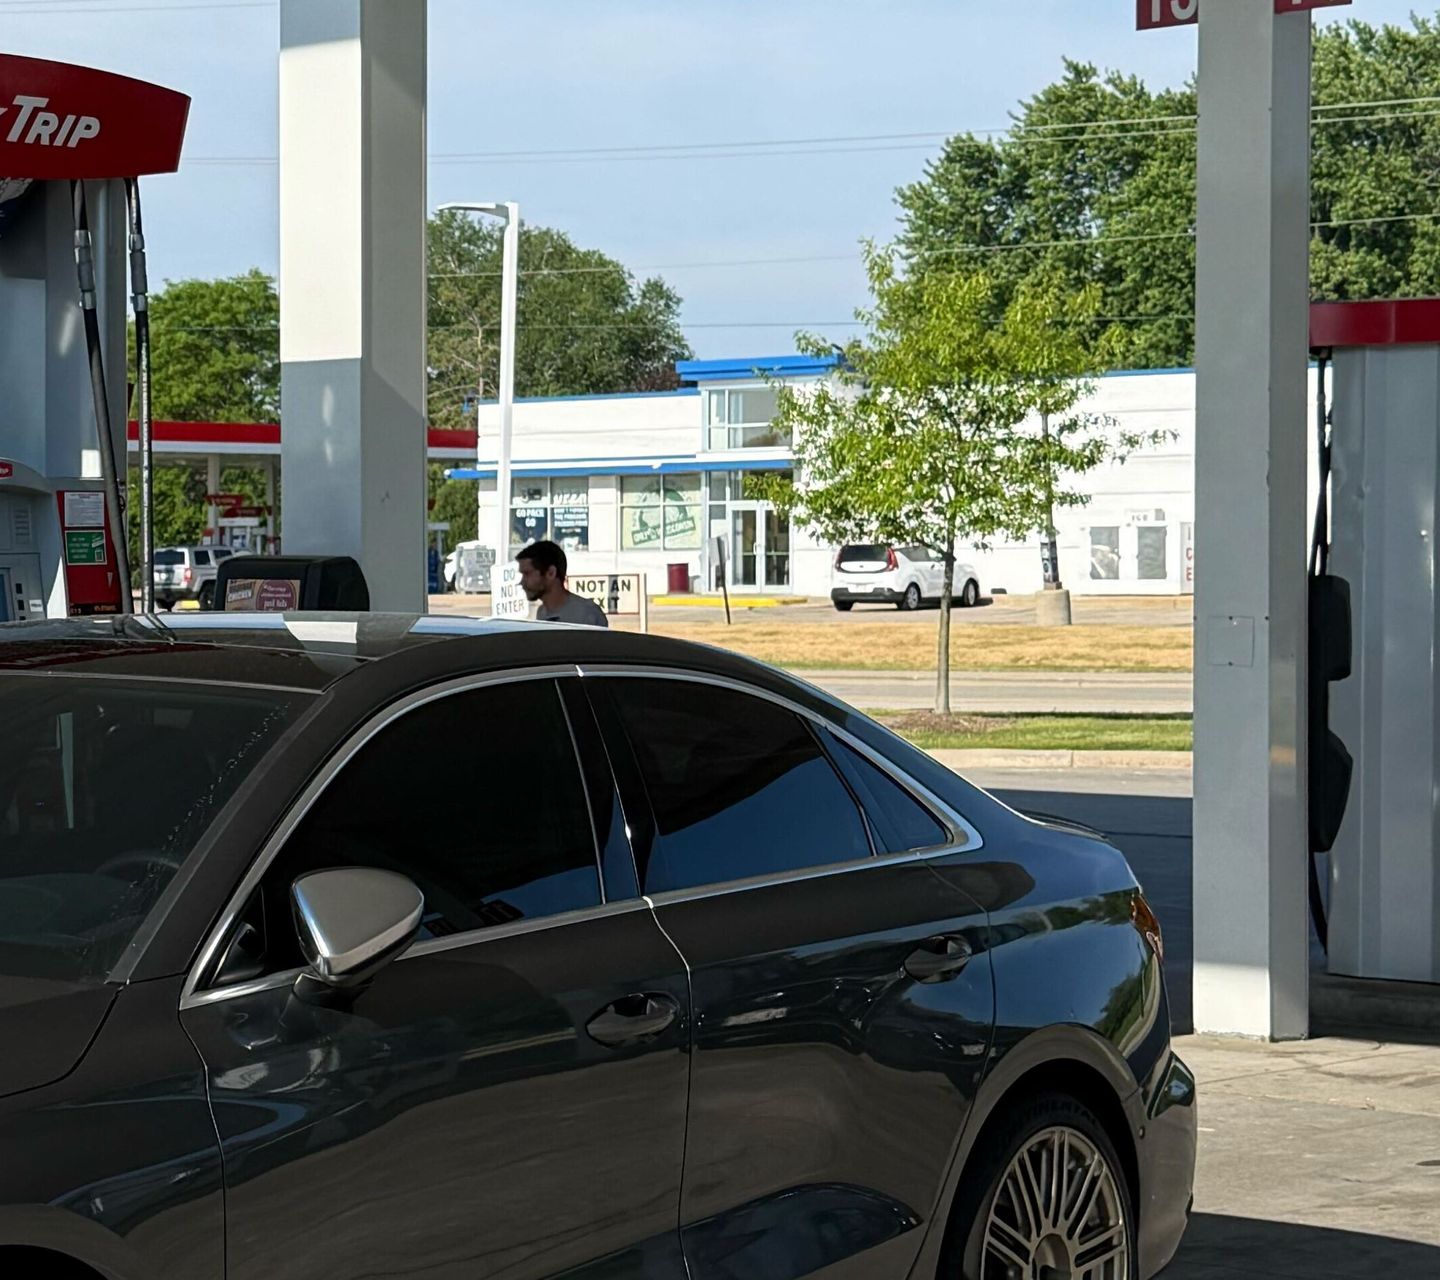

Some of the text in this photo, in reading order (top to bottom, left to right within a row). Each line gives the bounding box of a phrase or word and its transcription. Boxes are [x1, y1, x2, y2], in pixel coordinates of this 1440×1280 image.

[503, 569, 516, 581] DO
[576, 579, 631, 593] NOT AN
[496, 600, 525, 616] ENTER
